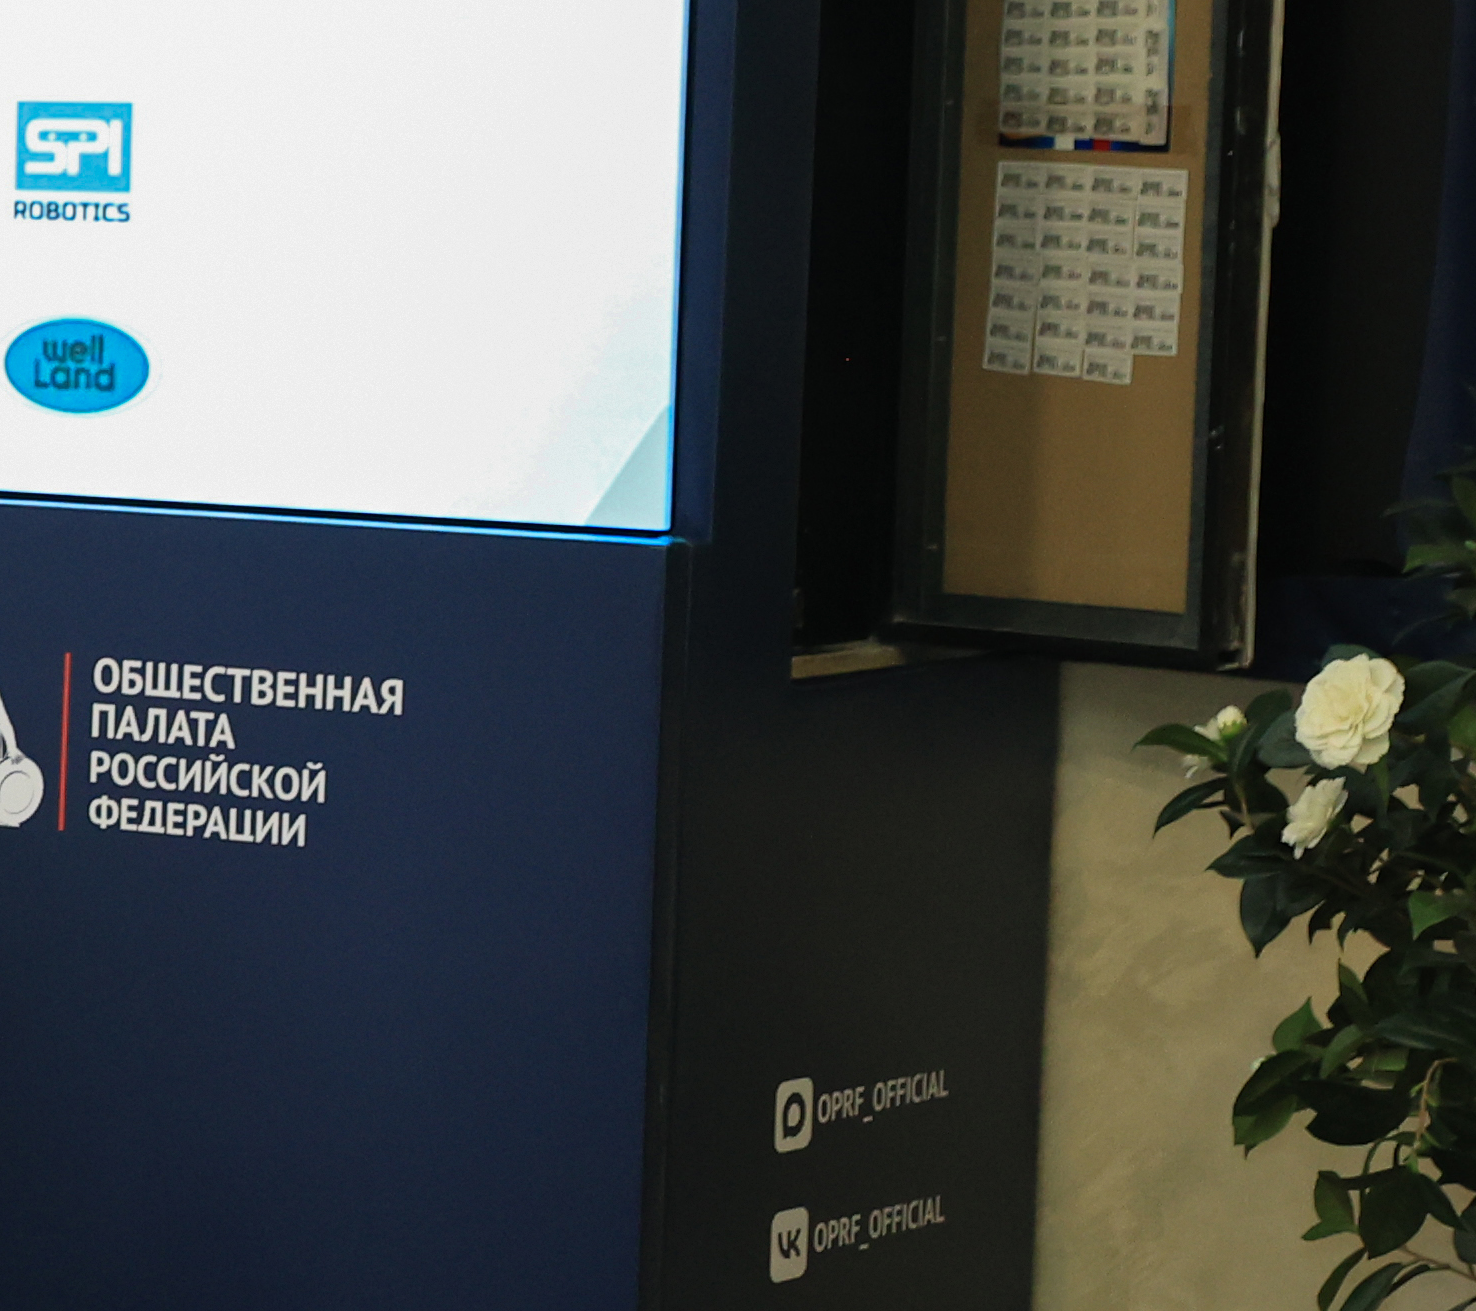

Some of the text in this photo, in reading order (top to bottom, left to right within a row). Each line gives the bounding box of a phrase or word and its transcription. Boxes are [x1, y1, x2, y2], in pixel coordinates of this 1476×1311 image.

[24, 118, 124, 177] SPI
[14, 200, 131, 223] ROBOTICS
[34, 361, 115, 392] Land
[43, 335, 105, 364] well
[92, 656, 404, 716] ОБЩЕСТВЕННАЯ
[89, 703, 236, 751] ПАЛАТА
[88, 748, 328, 805] РОССИЙСКОЙ
[88, 793, 306, 849] ФЕДЕРАЦИИ
[816, 1069, 949, 1125] OPRF_OFFICIAL
[813, 1194, 945, 1254] OPRF_OFFICIAL
